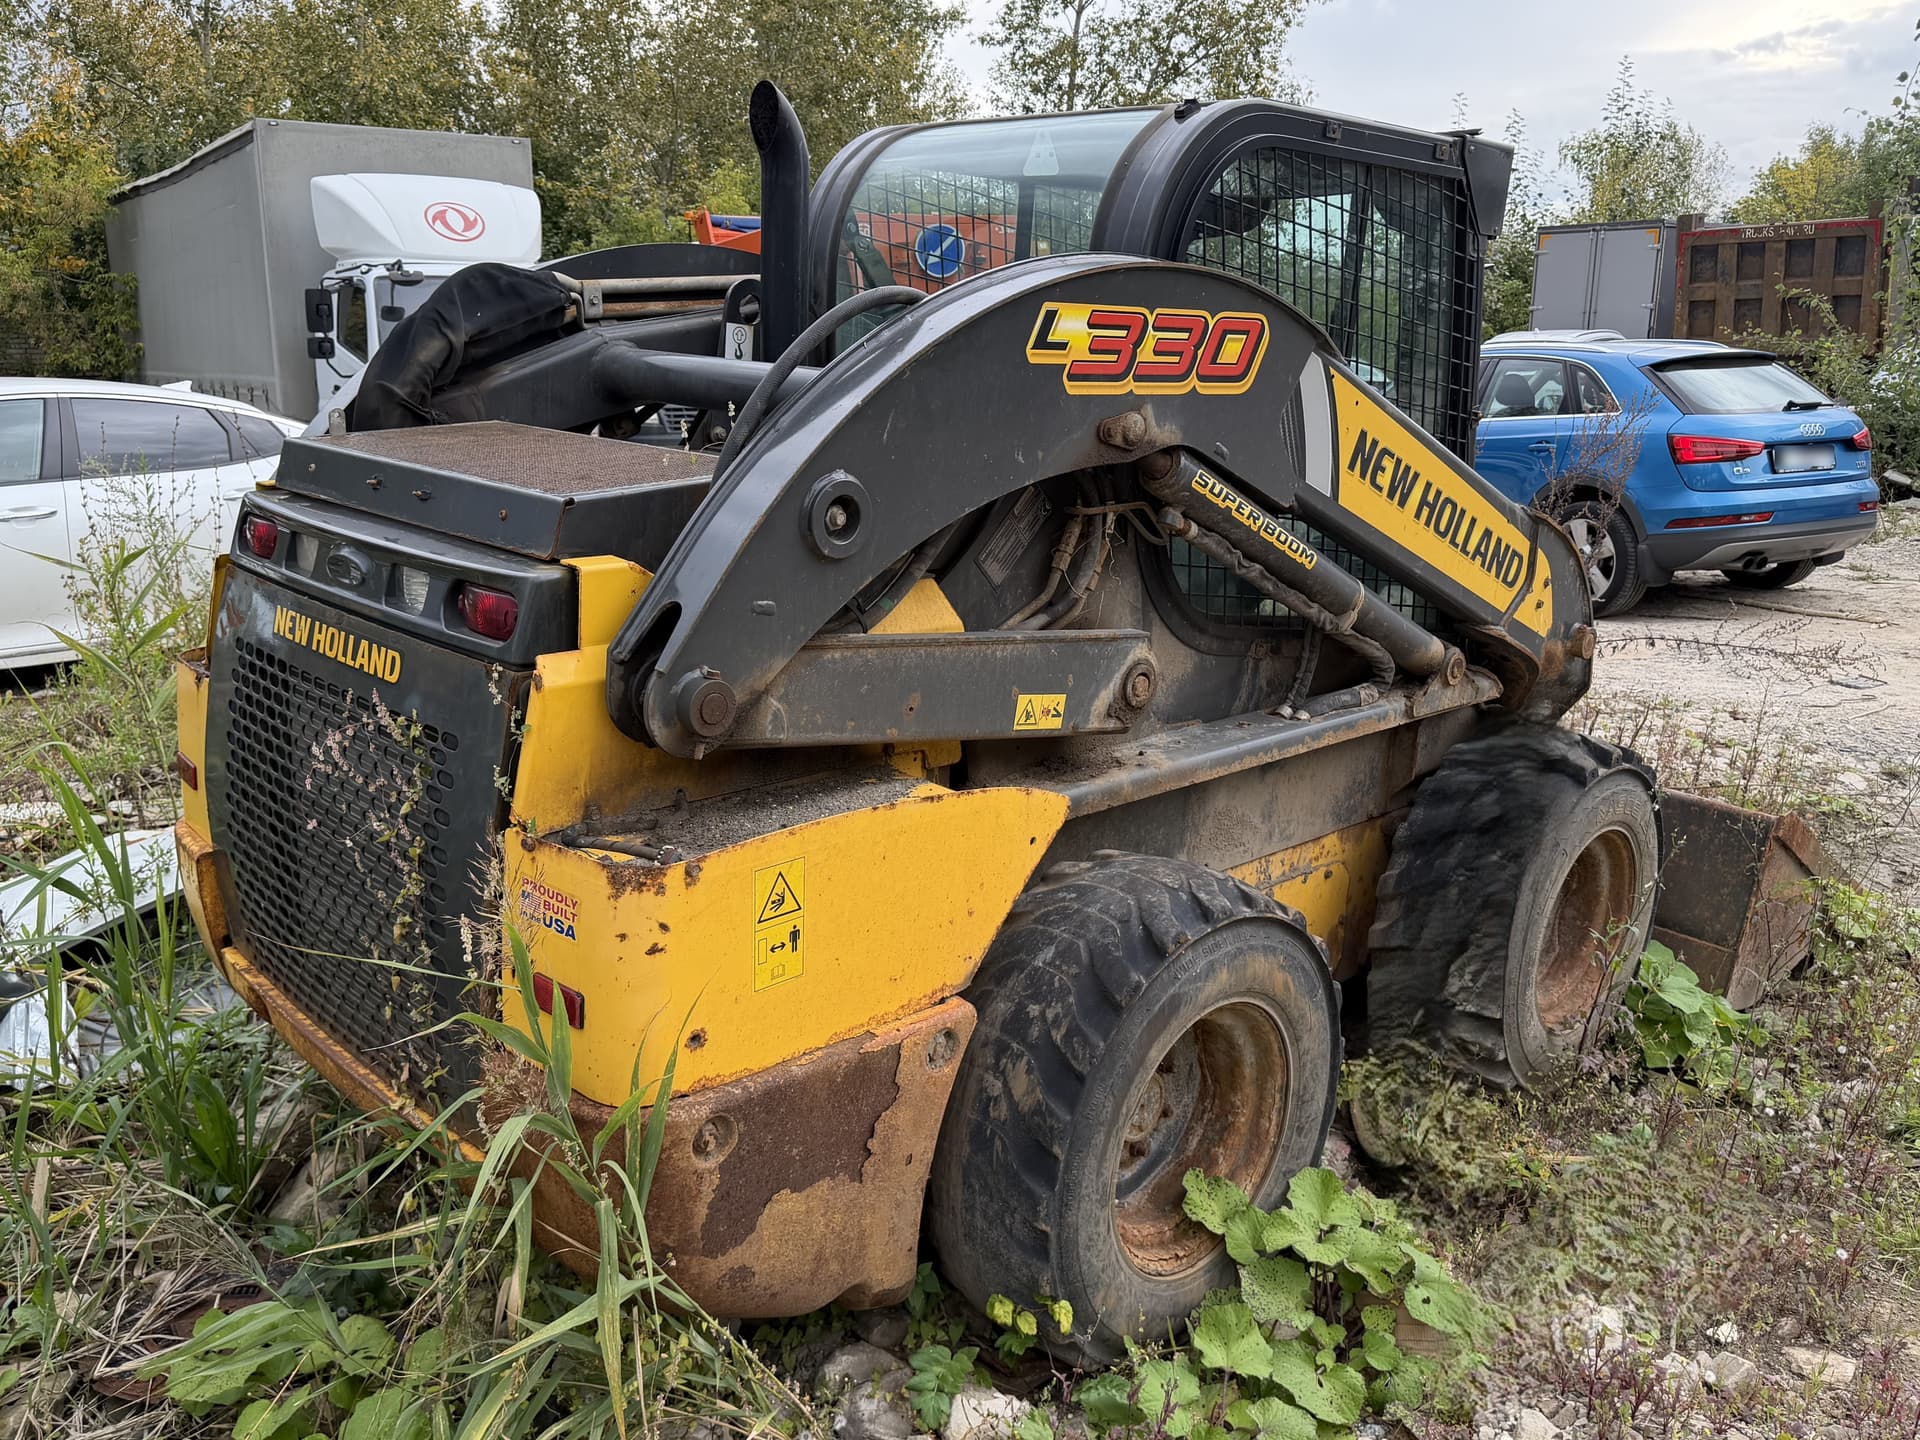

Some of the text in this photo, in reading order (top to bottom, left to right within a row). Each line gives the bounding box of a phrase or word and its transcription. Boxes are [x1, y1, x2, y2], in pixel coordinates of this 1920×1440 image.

[1028, 304, 1267, 391] L330
[1192, 469, 1317, 570] SUPER BOOM
[1347, 428, 1524, 589] NEW HOLLAND
[273, 605, 401, 684] NEW HOLLAND
[522, 876, 578, 910] PROUDLY
[542, 911, 577, 941] USA
[543, 899, 578, 923] BUILT
